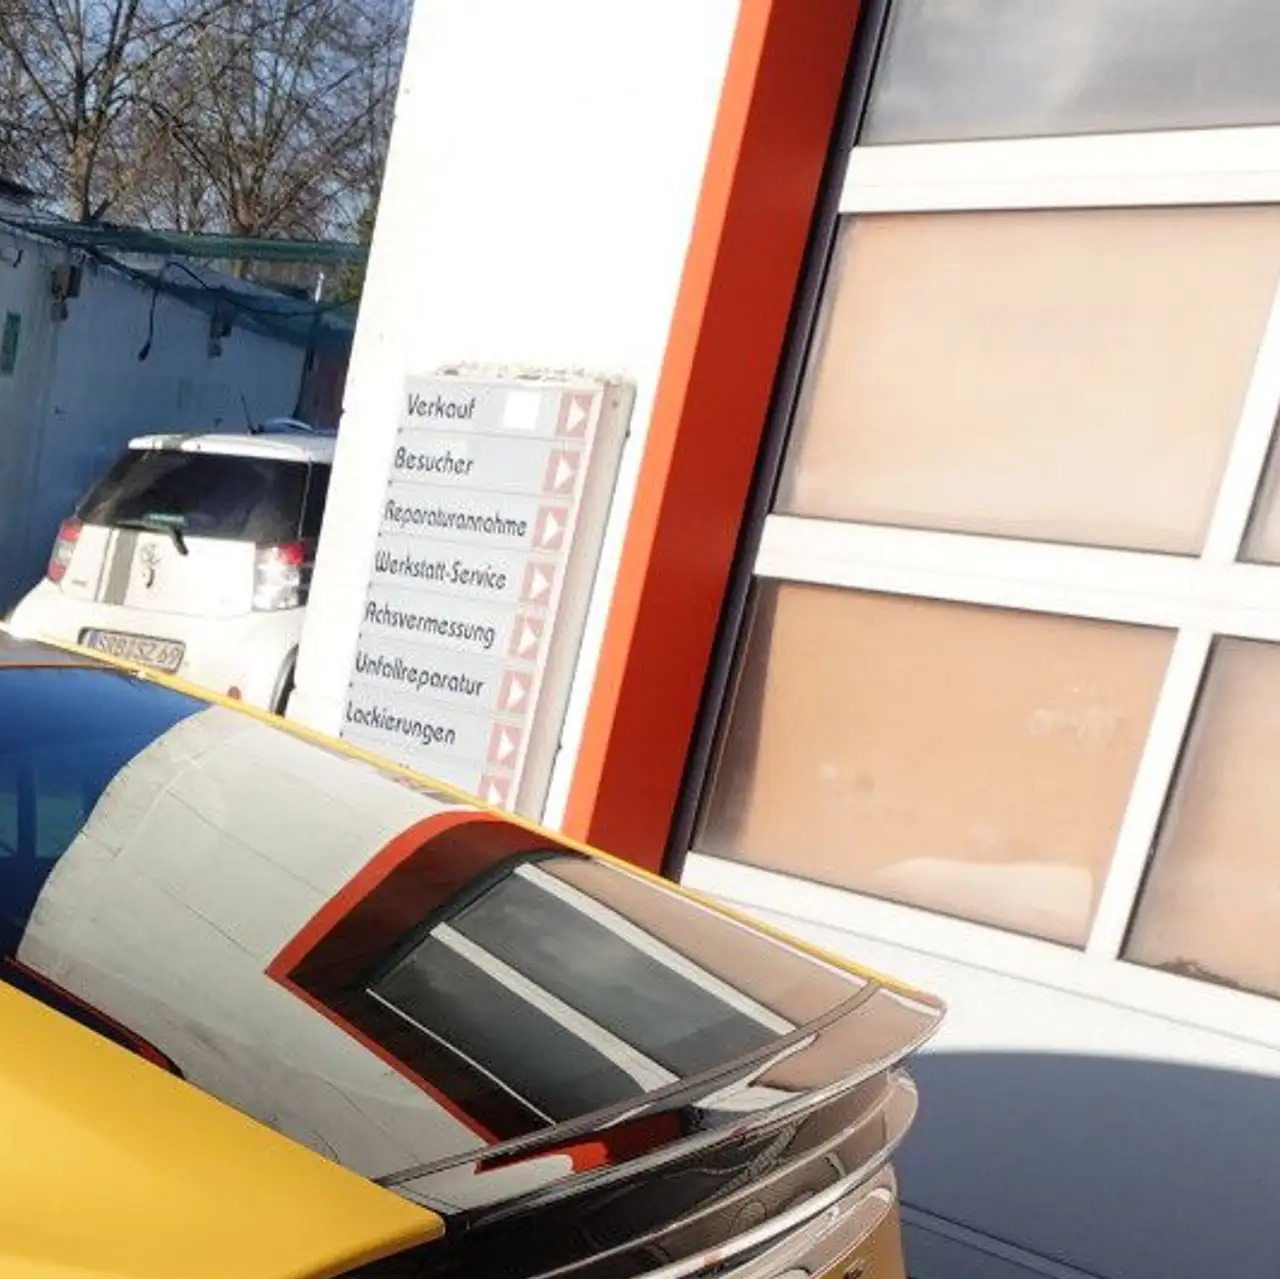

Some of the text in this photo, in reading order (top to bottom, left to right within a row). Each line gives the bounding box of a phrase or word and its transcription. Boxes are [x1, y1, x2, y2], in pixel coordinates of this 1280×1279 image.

[407, 392, 476, 419] Verkauf
[393, 446, 474, 475] Besucher
[384, 499, 528, 537] Reparaturannahme
[374, 550, 507, 590] Werkstatt-Service
[363, 600, 496, 649] Achsvermessung
[355, 650, 485, 696] Unfallreparatur
[345, 700, 457, 746] Lackierungen
